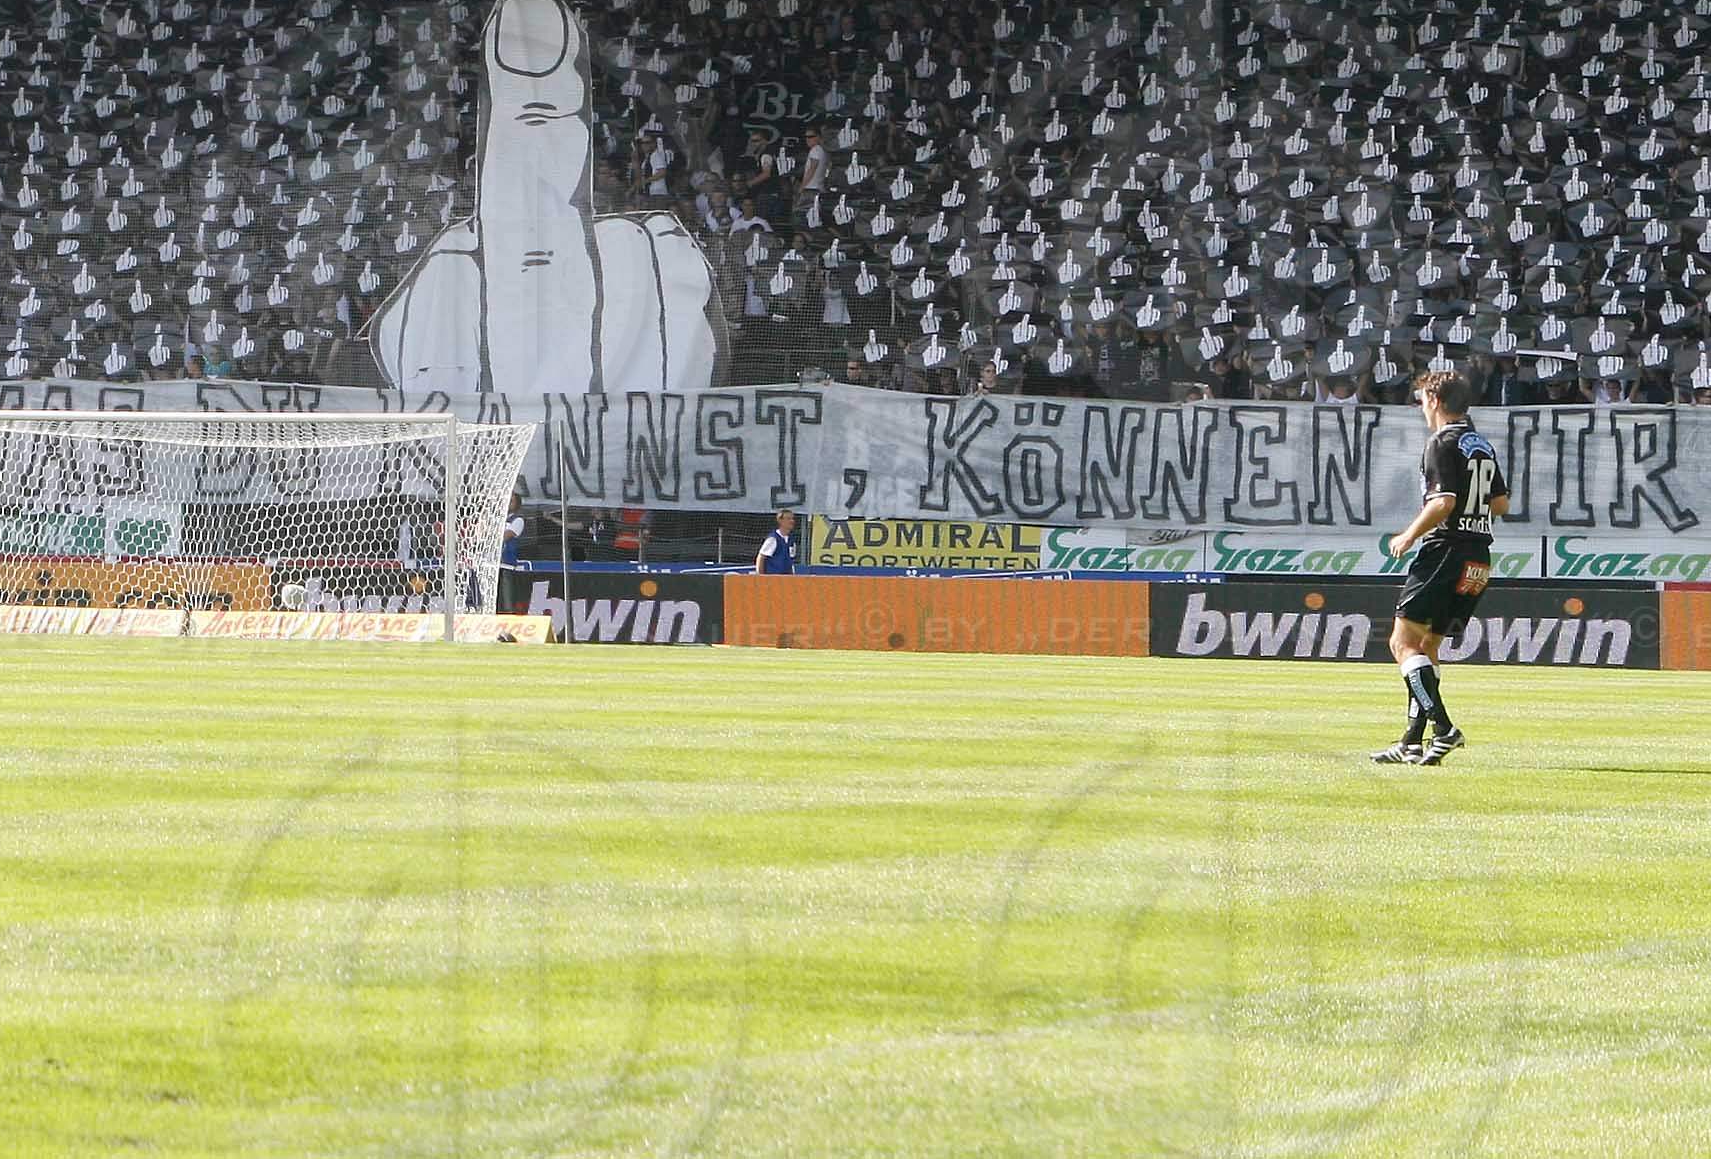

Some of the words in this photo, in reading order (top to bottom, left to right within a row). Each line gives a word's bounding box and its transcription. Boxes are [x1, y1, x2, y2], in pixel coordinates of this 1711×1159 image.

[920, 397, 1381, 526] KÖNNEN
[818, 554, 1041, 569] SPORTWETTEN
[822, 520, 1041, 554] ADMIRAL
[528, 579, 701, 644] bwin
[1176, 592, 1372, 658] bwin
